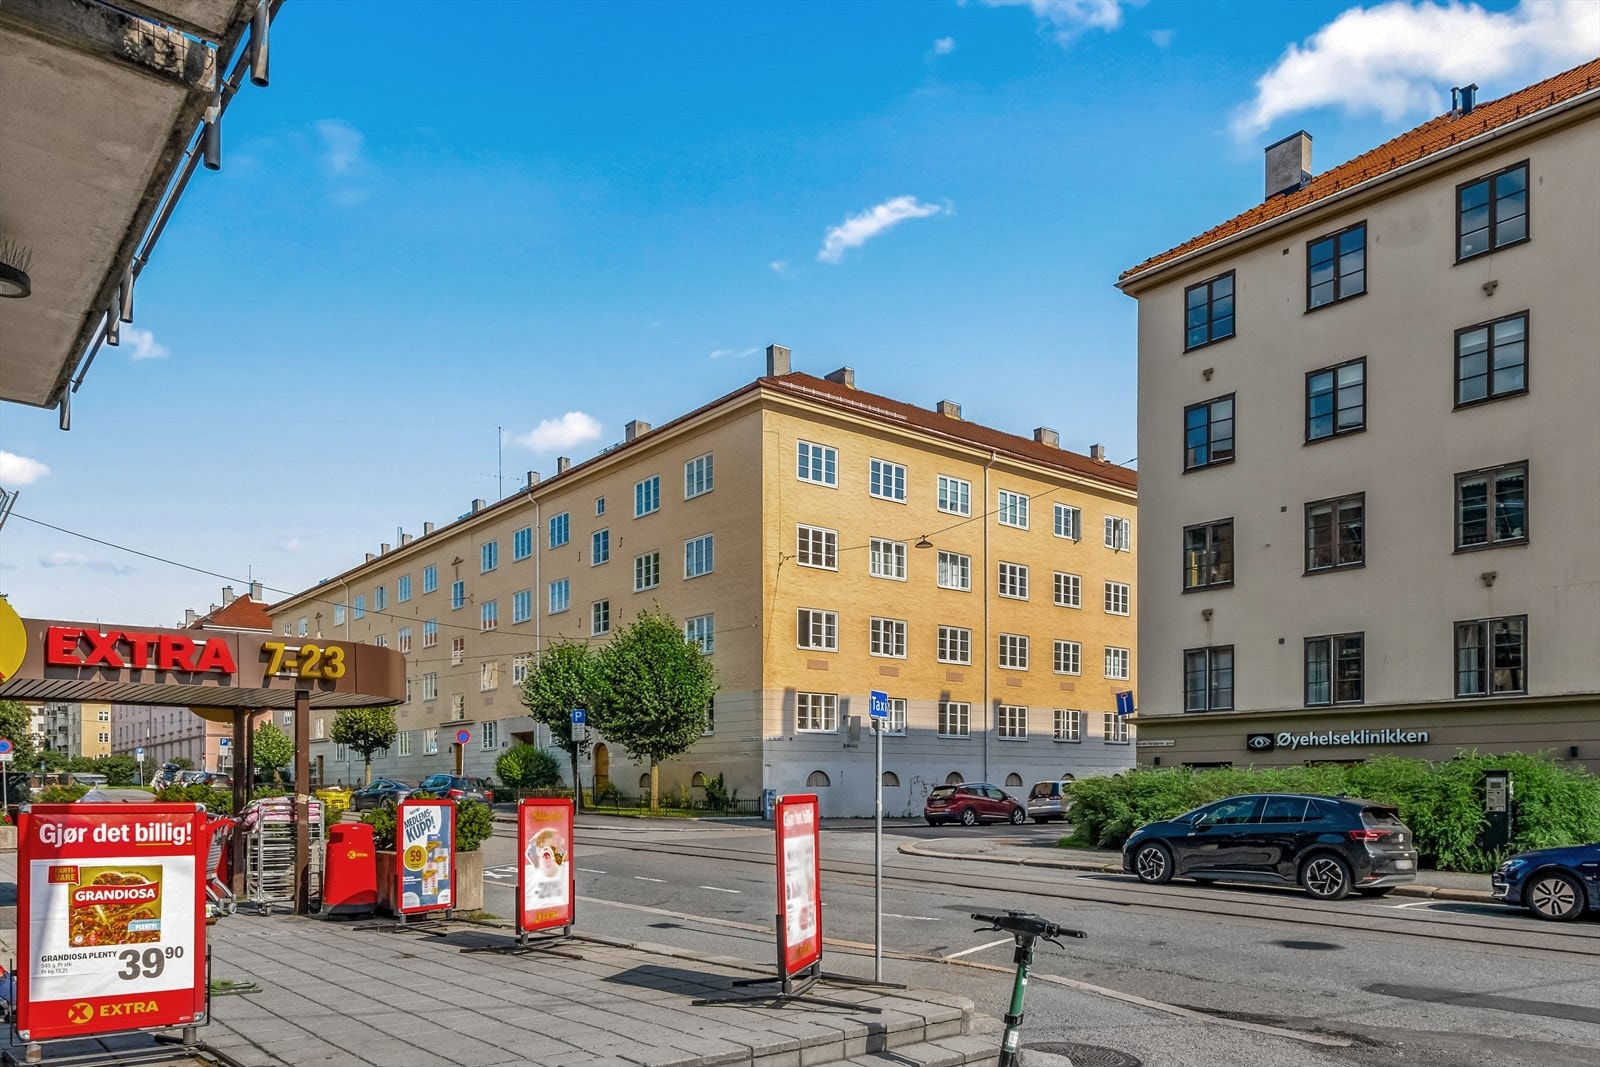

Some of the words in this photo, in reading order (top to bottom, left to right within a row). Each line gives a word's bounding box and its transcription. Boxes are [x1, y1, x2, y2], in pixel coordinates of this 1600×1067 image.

[47, 626, 237, 674] EXTRA
[263, 641, 347, 680] 7-23
[872, 696, 887, 712] Taxi
[575, 711, 582, 722] P
[1276, 728, 1429, 751] Øyehelseklinikken
[404, 808, 432, 829] MEDLEMS-
[39, 823, 88, 848] Gjør
[92, 823, 130, 843] det
[135, 822, 192, 845] billig!
[406, 816, 436, 843] KUPP!
[410, 849, 422, 862] 59
[75, 888, 155, 902] GRANDIOSA
[41, 953, 88, 962] GRANDIOSA
[89, 950, 117, 959] PLENTY
[118, 947, 165, 980] 39
[165, 946, 184, 959] 90
[100, 1000, 159, 1017] EXTRA
